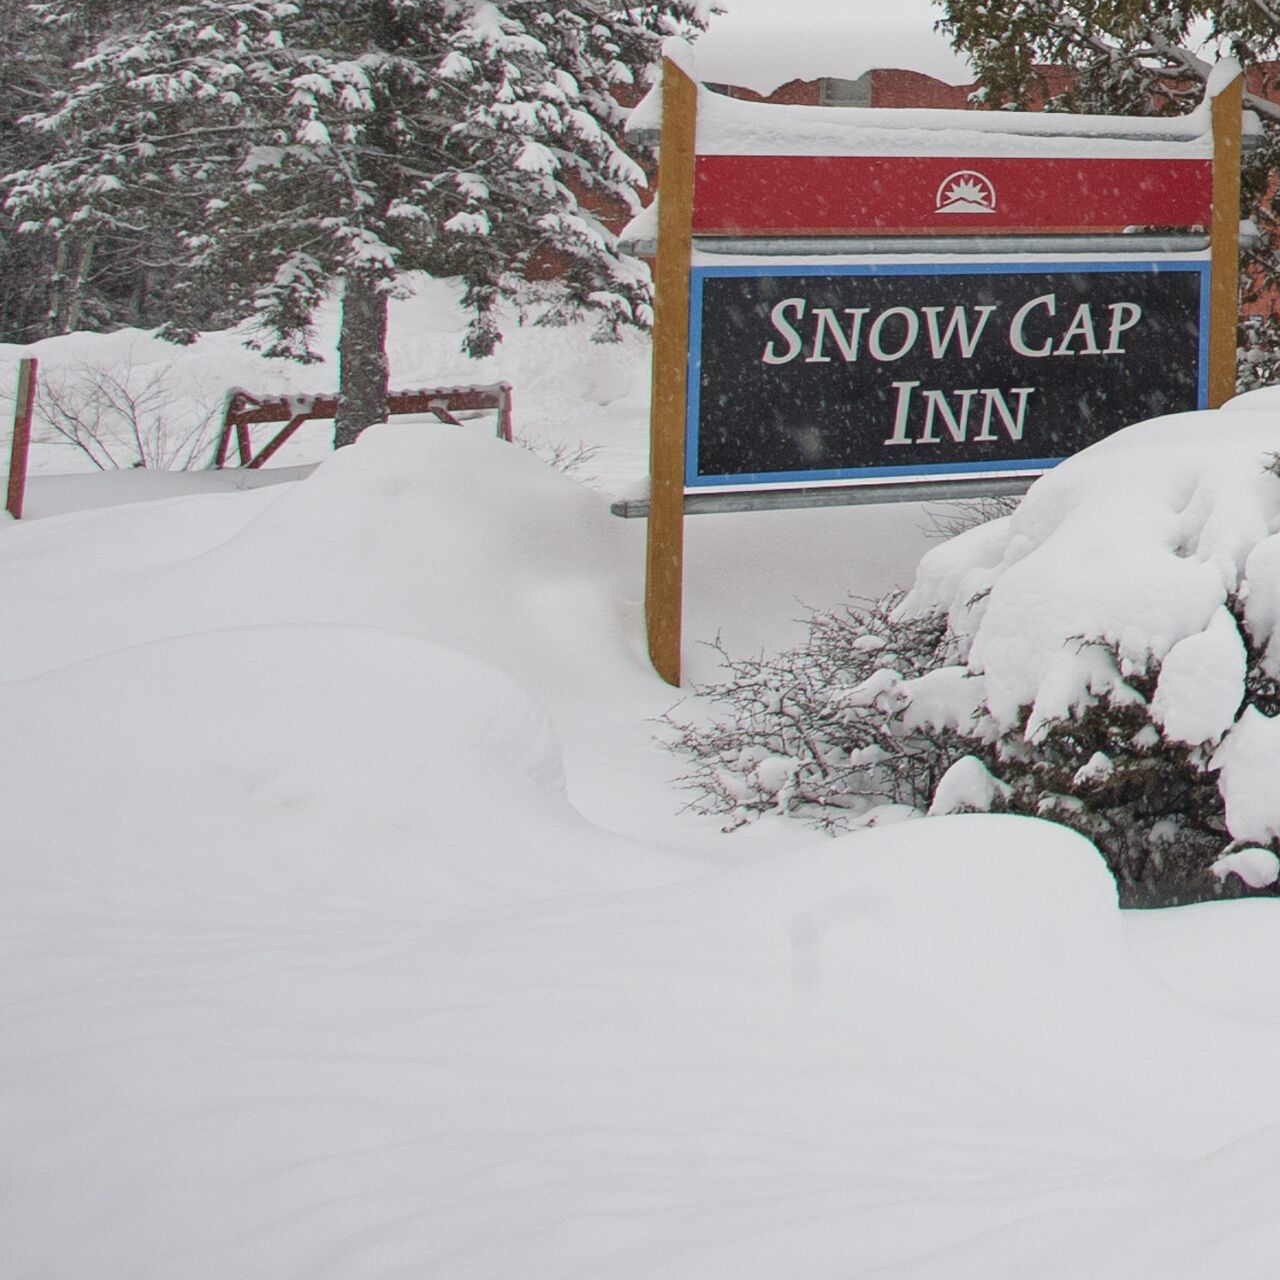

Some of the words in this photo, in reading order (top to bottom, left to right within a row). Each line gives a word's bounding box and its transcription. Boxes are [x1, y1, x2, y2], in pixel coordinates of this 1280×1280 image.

[761, 297, 997, 366] SNOW
[1008, 292, 1142, 358] CAP
[883, 380, 1036, 447] INN
